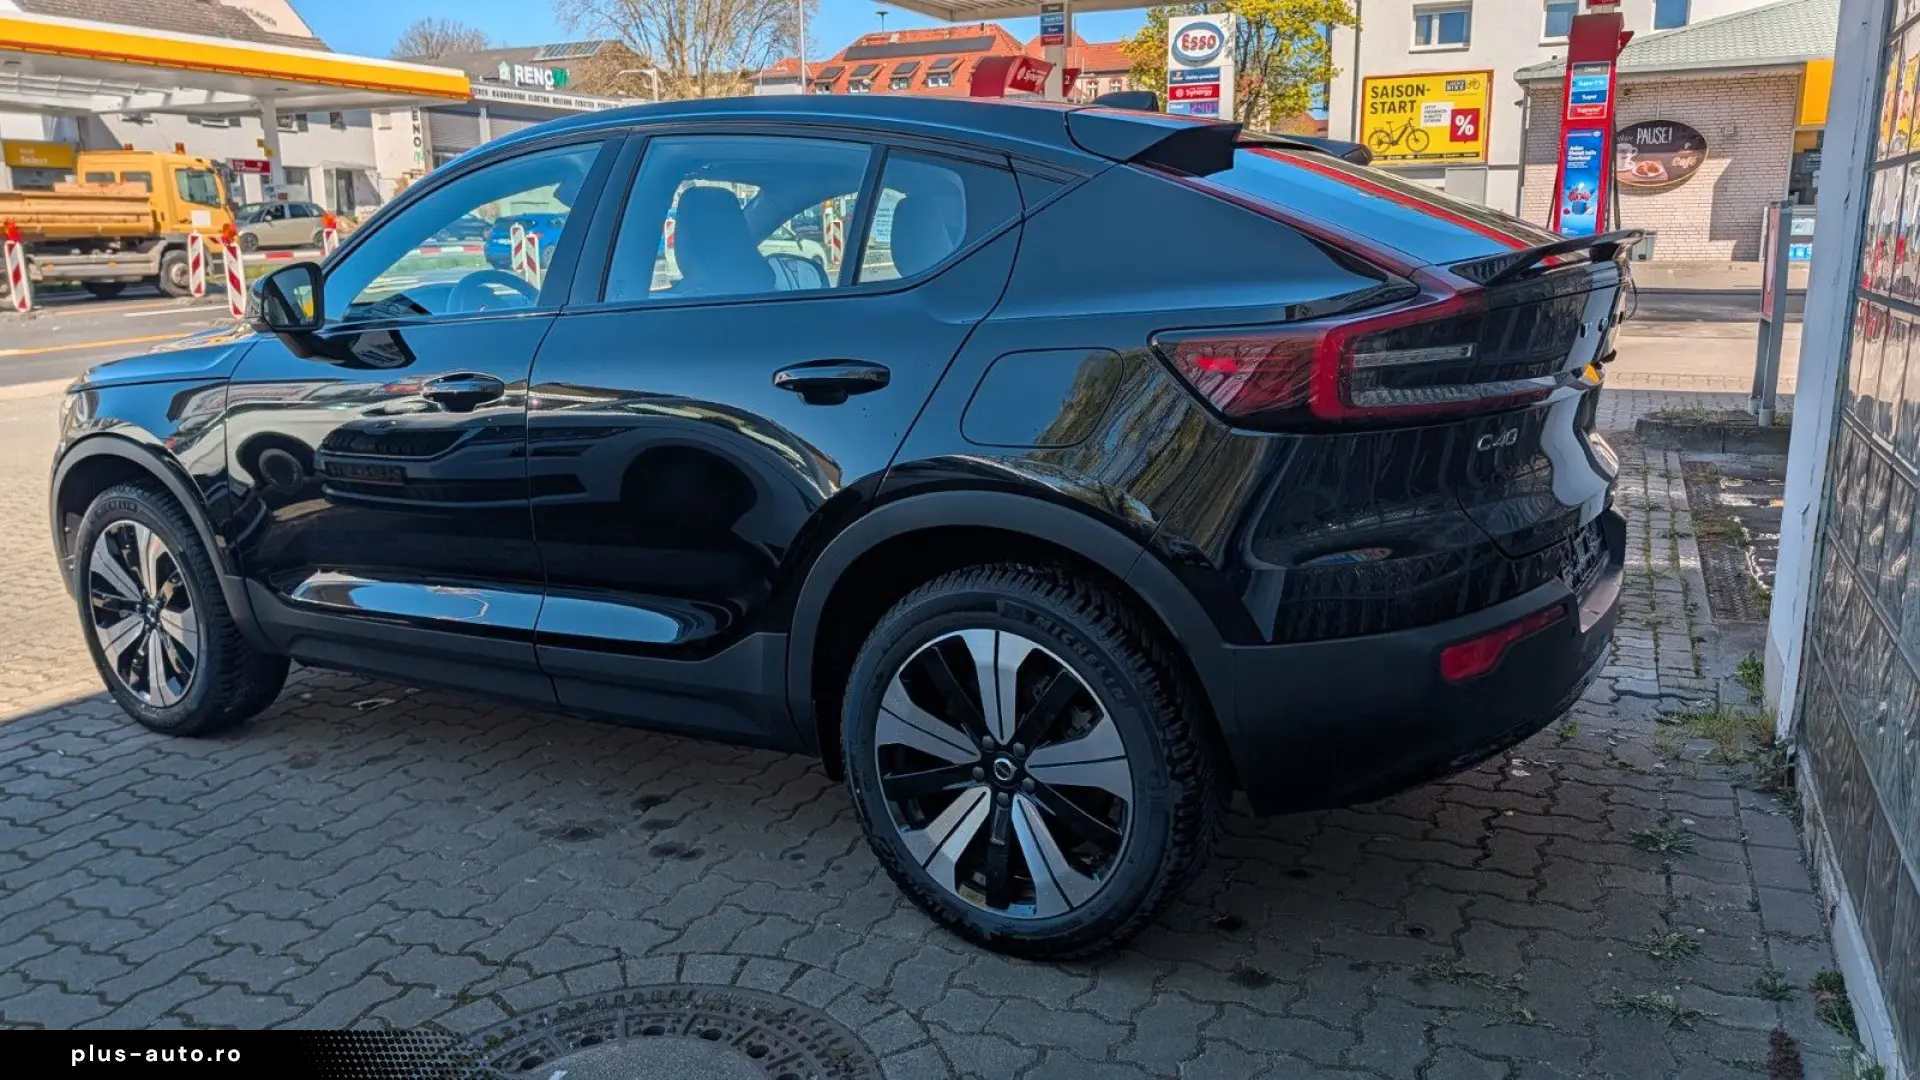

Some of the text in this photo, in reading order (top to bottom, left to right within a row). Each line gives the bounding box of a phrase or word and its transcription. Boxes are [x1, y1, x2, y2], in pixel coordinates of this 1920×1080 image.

[1181, 33, 1217, 51] Esso
[1186, 89, 1212, 98] Synergy
[1371, 83, 1431, 99] SAISON-
[1370, 99, 1416, 115] START
[1455, 114, 1475, 137] %
[1636, 126, 1673, 145] PAUSE!
[1671, 155, 1699, 169] Café
[1477, 427, 1519, 452] C40
